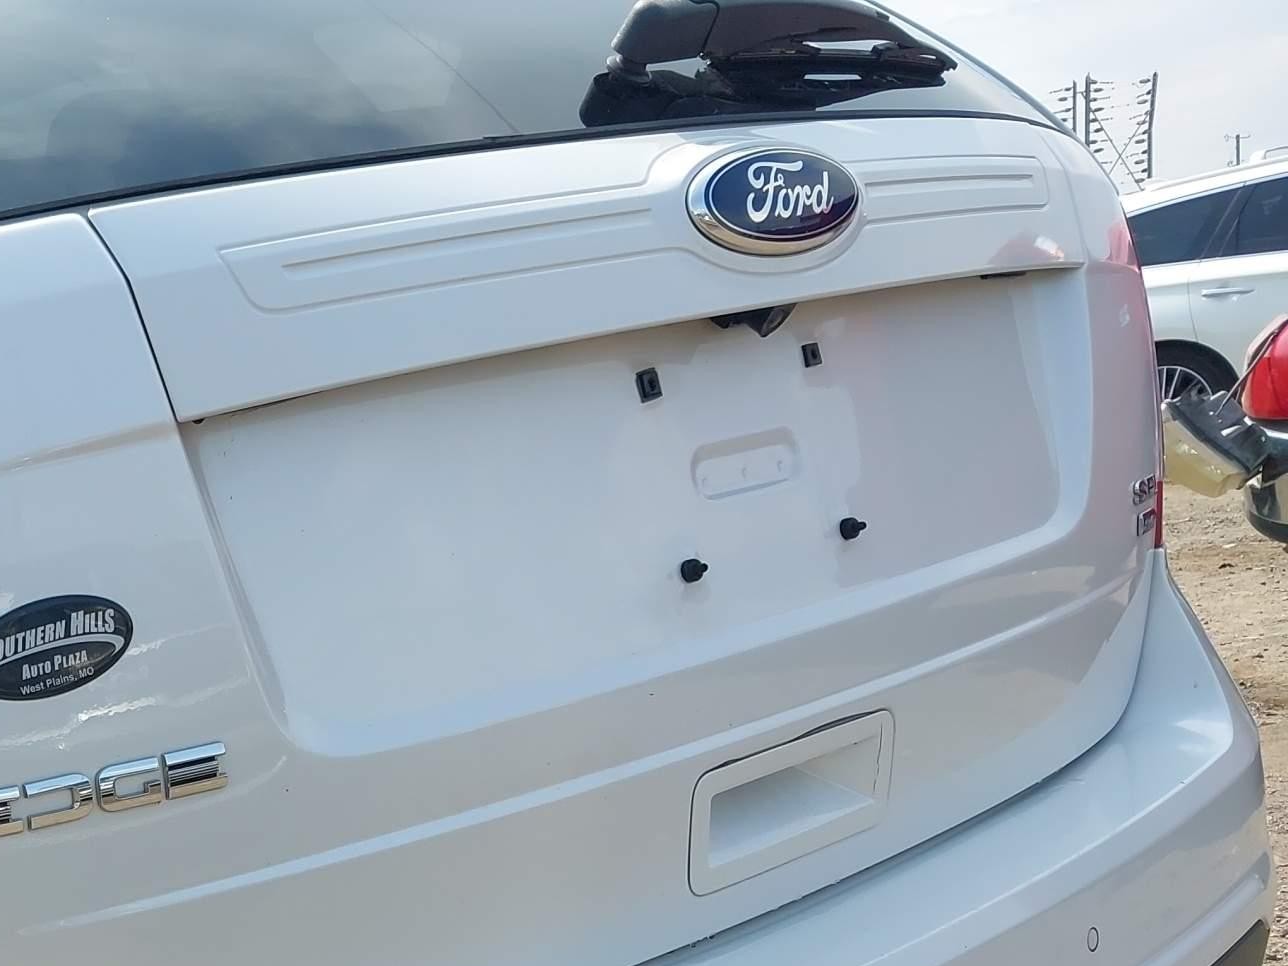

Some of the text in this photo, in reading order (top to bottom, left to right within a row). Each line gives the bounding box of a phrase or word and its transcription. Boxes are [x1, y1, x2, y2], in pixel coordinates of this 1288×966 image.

[746, 160, 834, 223] Ford
[70, 608, 115, 636] HILLS
[22, 650, 88, 681] AUTO PLAZA
[19, 666, 95, 696] West Plains, MO
